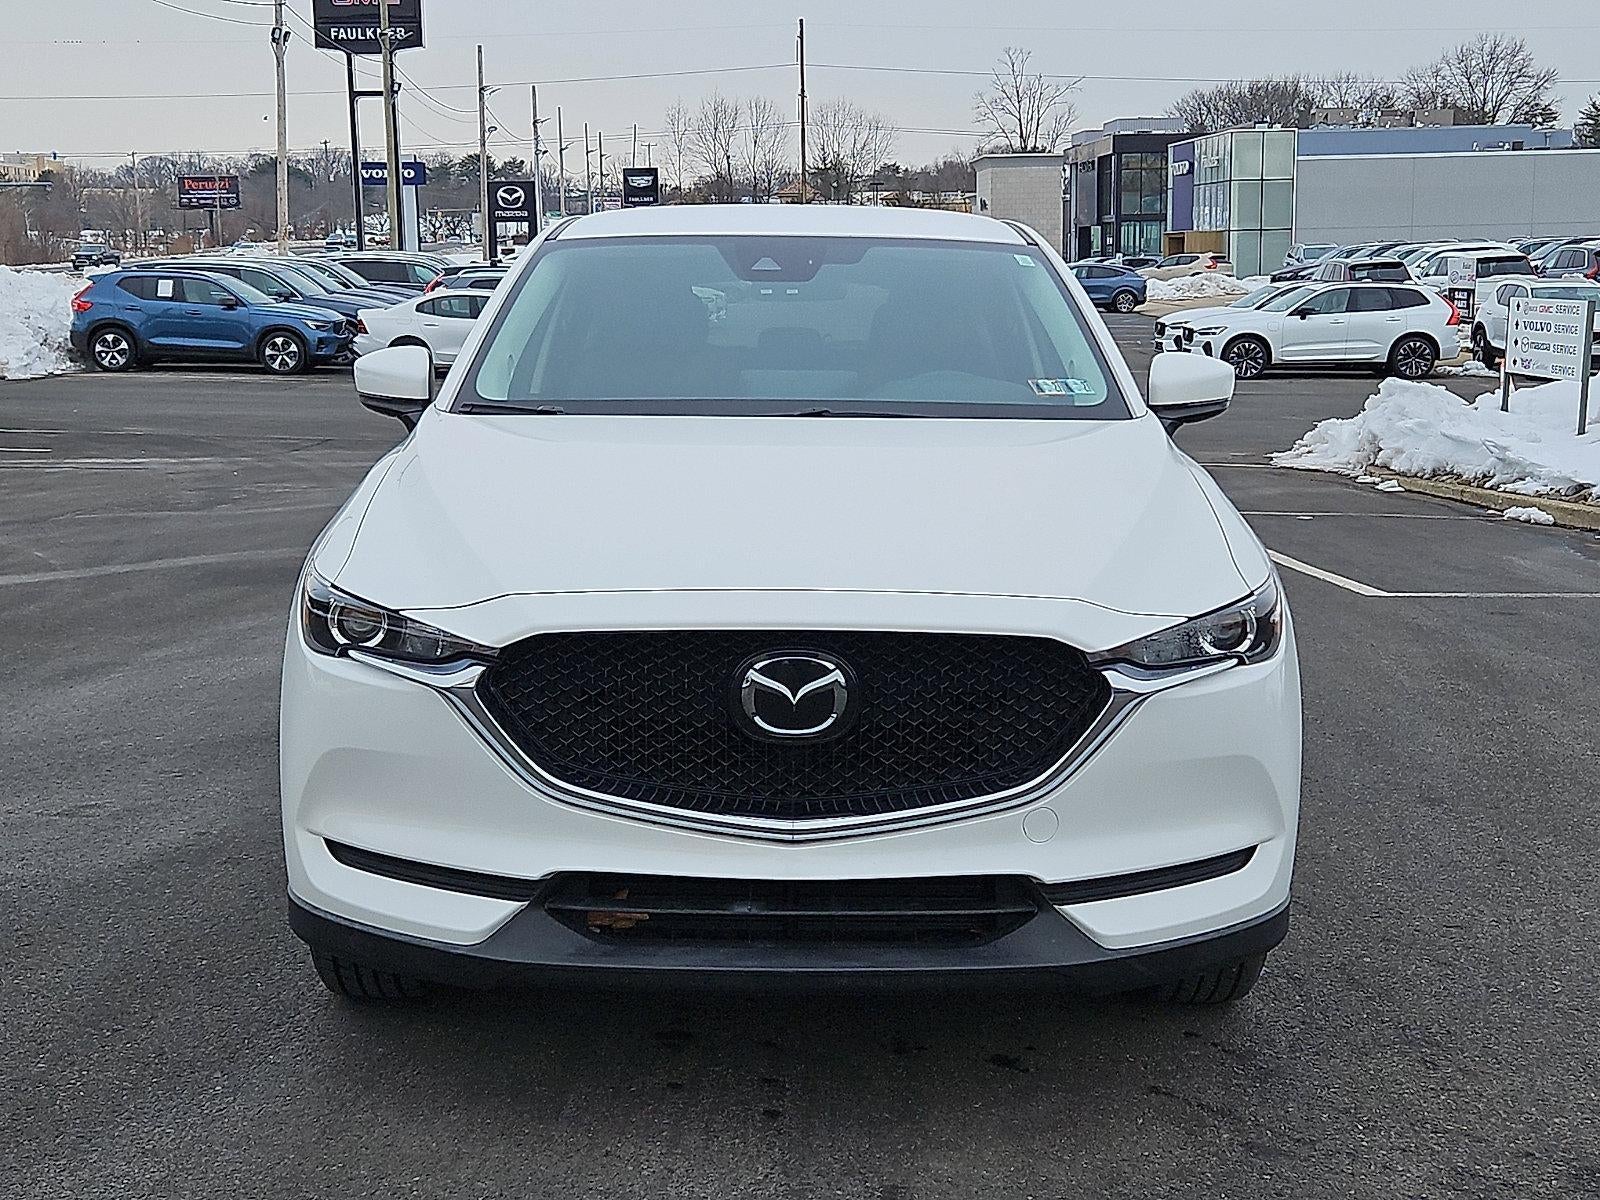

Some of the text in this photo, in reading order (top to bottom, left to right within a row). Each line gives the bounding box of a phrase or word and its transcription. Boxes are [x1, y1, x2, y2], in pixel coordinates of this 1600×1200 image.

[1555, 304, 1580, 316] SERVICE
[1522, 320, 1579, 335] VOLVO SERVICE
[1552, 343, 1577, 356] SERVICE
[1551, 364, 1575, 377] SERVICE
